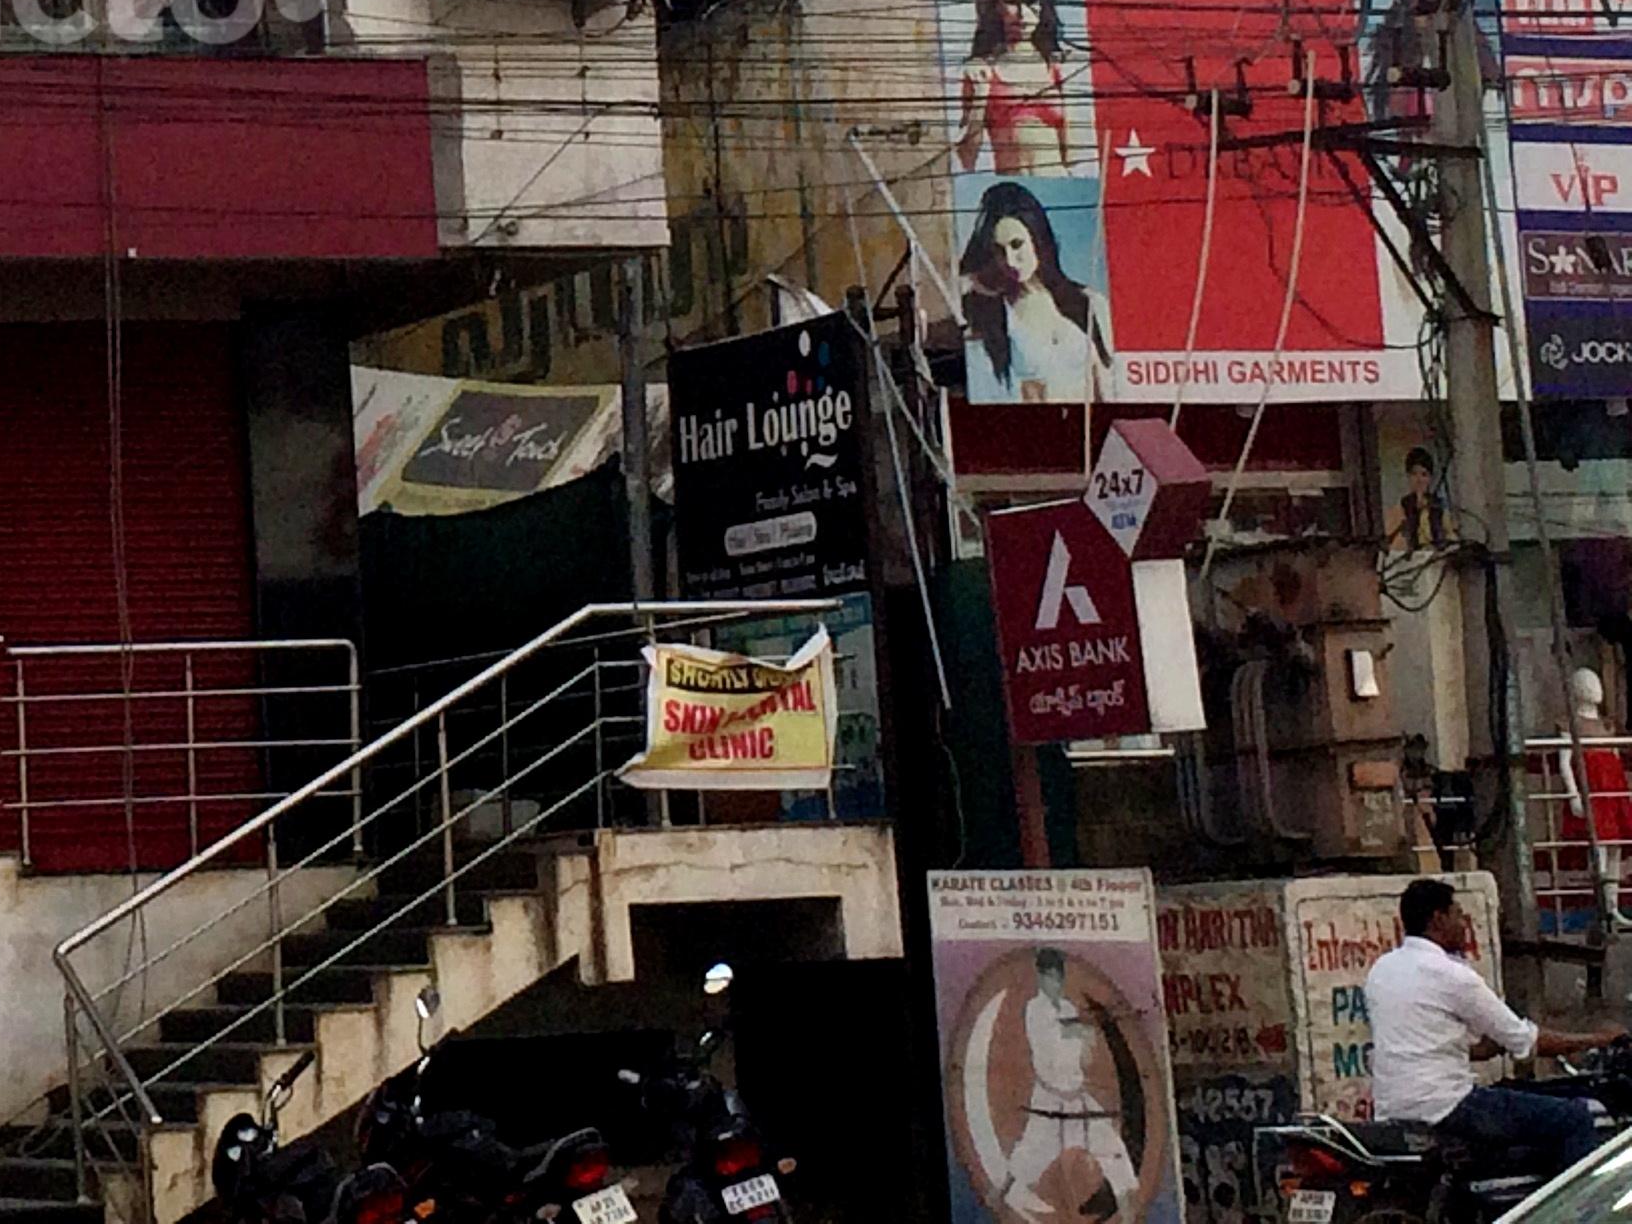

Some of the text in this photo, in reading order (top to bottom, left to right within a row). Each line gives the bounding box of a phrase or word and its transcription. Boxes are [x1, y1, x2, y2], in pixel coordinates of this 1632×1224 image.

[1550, 170, 1618, 206] VIP
[1127, 359, 1381, 385] SIDDHI GARMENTS
[680, 389, 853, 463] Hair Lounge
[1095, 468, 1144, 500] 24x7
[1016, 635, 1130, 674] AXIS BANK
[688, 726, 775, 761] CLINIC
[933, 877, 986, 891] KARATE
[990, 876, 1053, 891] CLASSES
